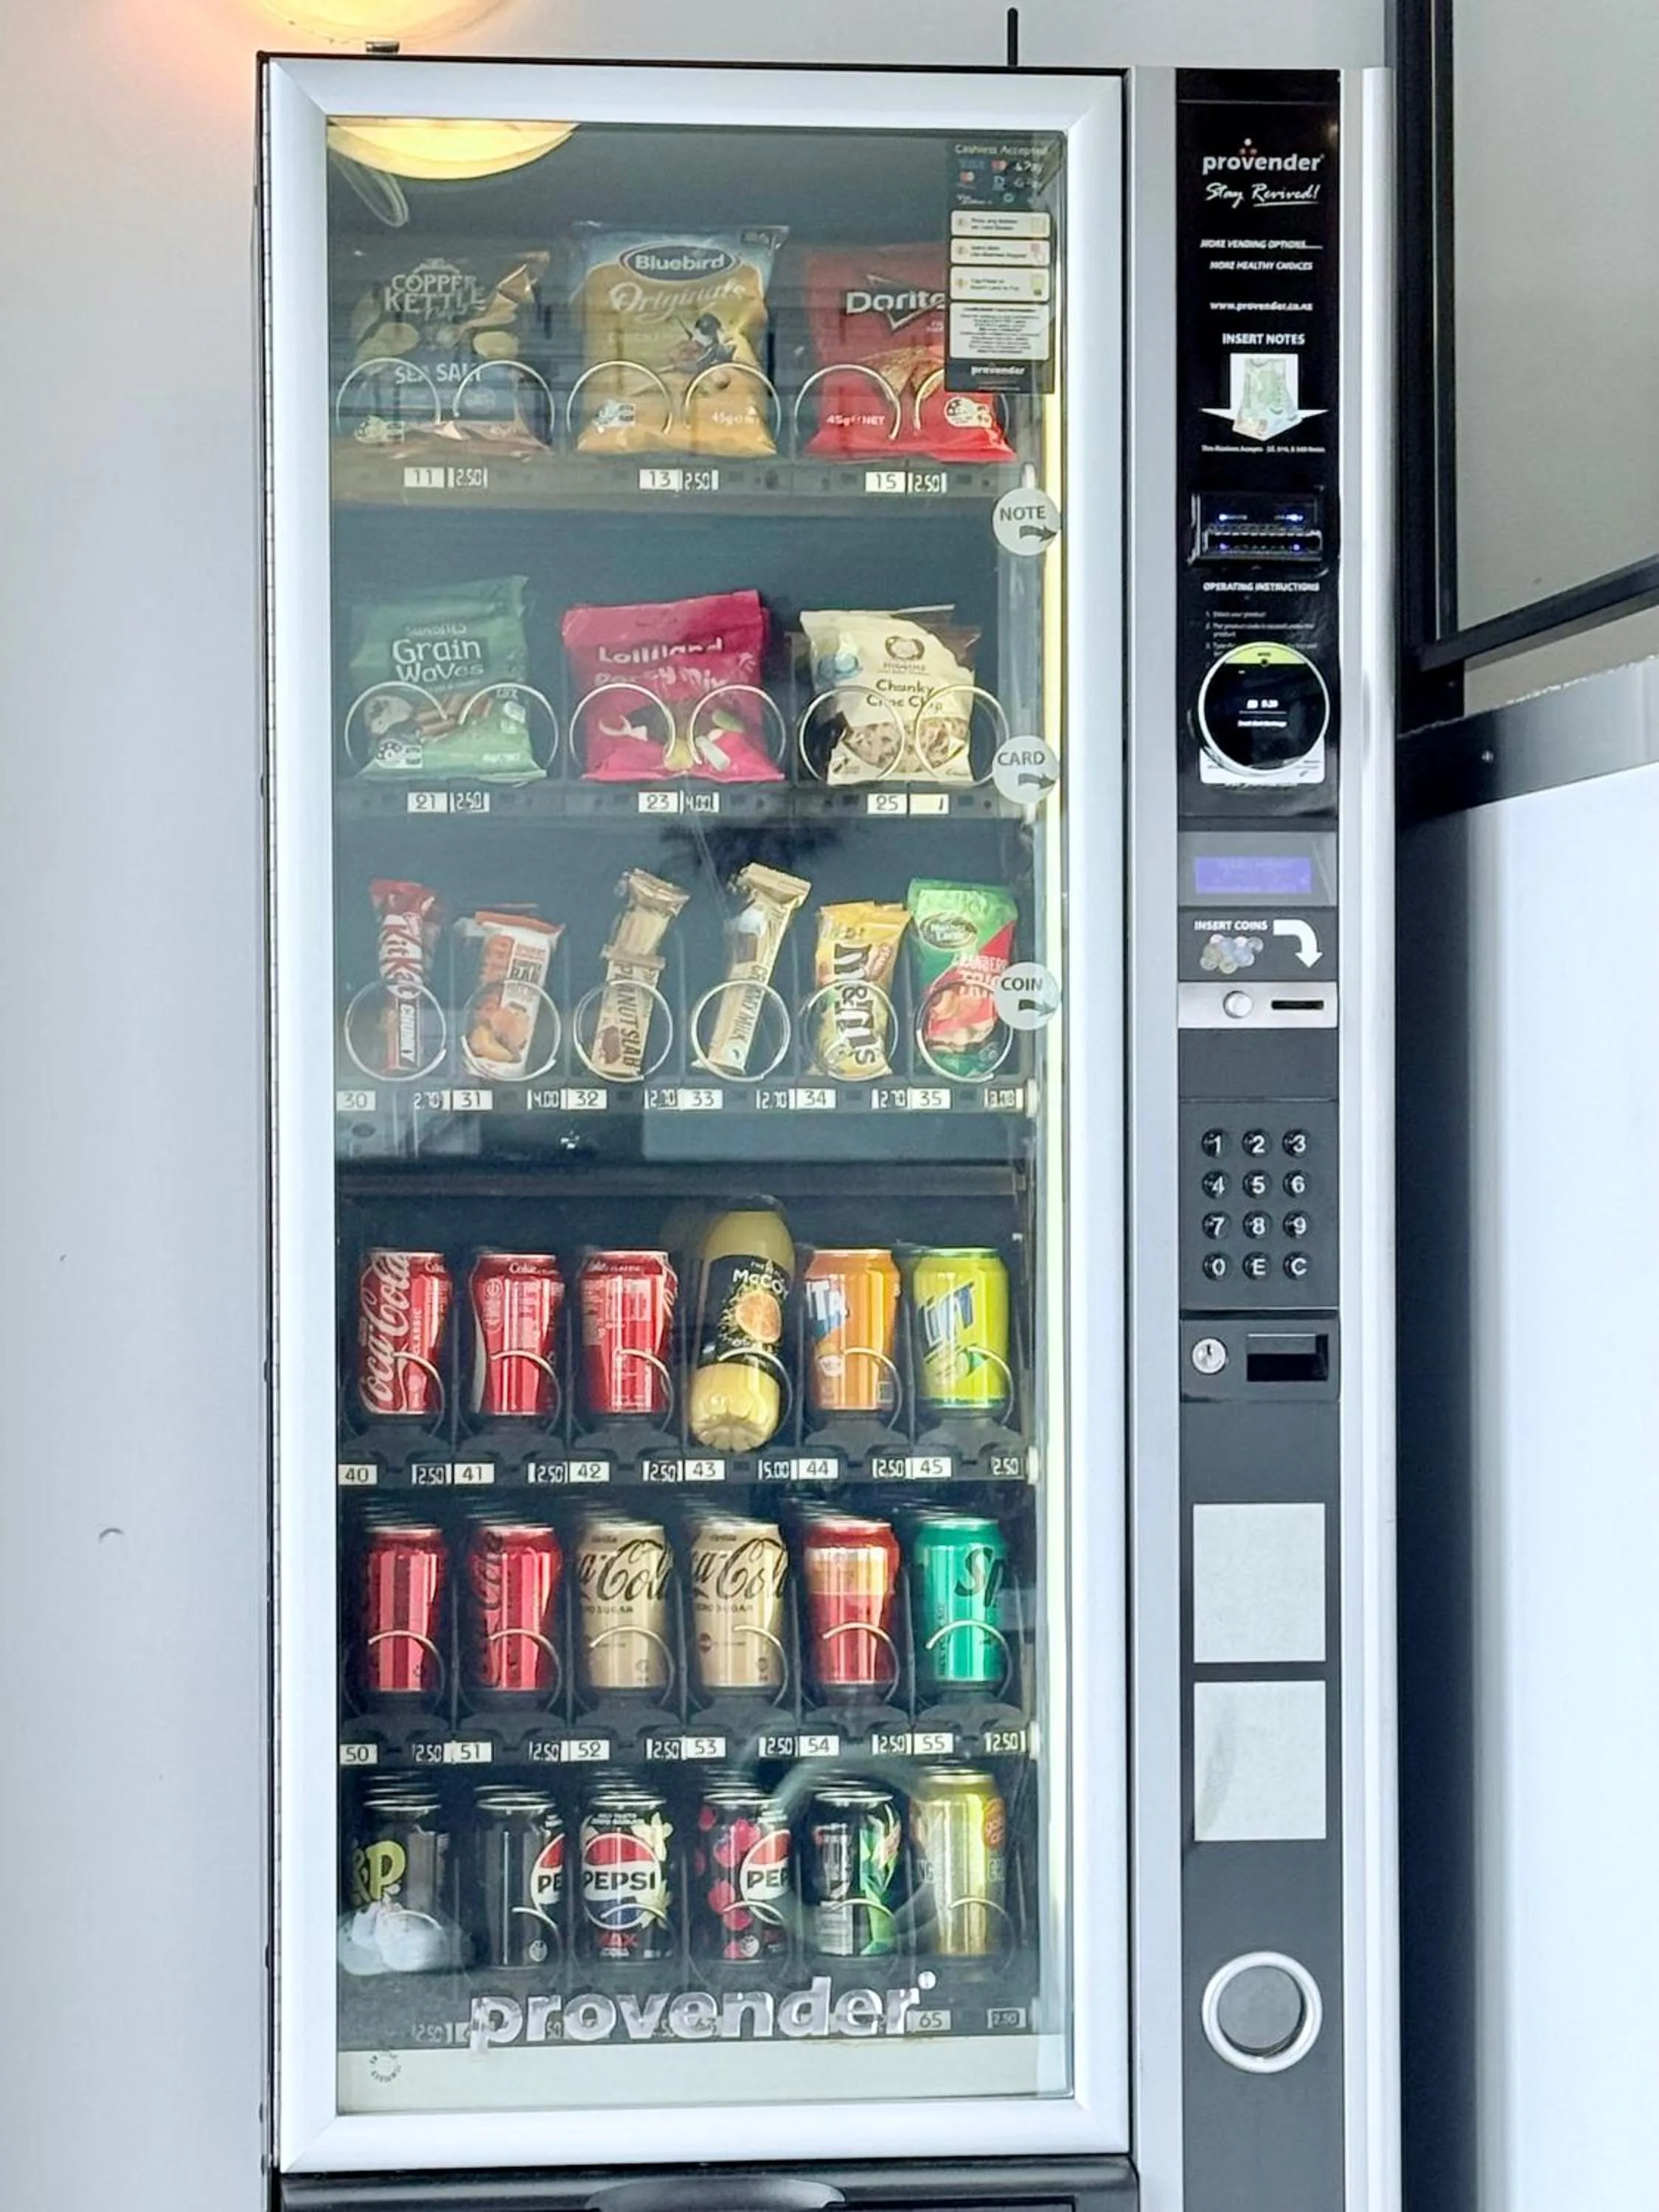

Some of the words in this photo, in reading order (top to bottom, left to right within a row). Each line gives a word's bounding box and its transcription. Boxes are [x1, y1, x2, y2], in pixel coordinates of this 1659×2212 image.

[1202, 153, 1324, 175] provender
[1206, 182, 1245, 209] Stay
[1251, 183, 1321, 204] Revived!
[634, 254, 725, 271] Bluebird
[392, 274, 477, 293] COPPER
[384, 286, 487, 314] KETTLE
[846, 291, 945, 314] Dorito
[1210, 301, 1313, 312] www.provender.co.nz
[1222, 333, 1263, 345] INSERT
[1265, 333, 1306, 345] NOTES
[414, 470, 431, 485] 11
[456, 469, 482, 487] 2.50
[650, 470, 671, 487] 13
[684, 472, 710, 490] 2.50
[876, 473, 896, 489] 15
[914, 474, 941, 492] 2.50
[1000, 505, 1047, 521] NOTE
[1203, 581, 1253, 592] OPERATING
[1255, 581, 1321, 592] INSTRUCTIONS
[392, 639, 481, 664] Grain
[598, 636, 723, 664] Lolliland
[396, 662, 484, 683] Waves
[876, 678, 934, 699] Chunky
[998, 751, 1046, 766] CARD
[414, 793, 437, 810] 21
[456, 792, 483, 812] 2.50
[646, 793, 670, 811] 23
[875, 795, 899, 812] 25
[1194, 919, 1233, 931] INSERT
[1234, 919, 1268, 931] COINS
[1000, 976, 1043, 992] COIN
[344, 1093, 367, 1108] 30
[460, 1092, 481, 1107] 31
[577, 1092, 599, 1106] 32
[692, 1091, 714, 1106] 33
[803, 1091, 827, 1105] 34
[919, 1091, 942, 1105] 35
[1213, 1135, 1222, 1154] 1
[1252, 1135, 1265, 1153] 2
[1293, 1135, 1306, 1152] 3
[1211, 1176, 1225, 1194] 4
[1252, 1176, 1266, 1194] 5
[1291, 1175, 1305, 1194] 6
[1212, 1217, 1225, 1236] 7
[1252, 1217, 1266, 1235] 8
[1293, 1216, 1307, 1235] 9
[1211, 1258, 1225, 1276] 0
[1252, 1258, 1266, 1276] E
[1291, 1257, 1308, 1276] C
[344, 1468, 369, 1482] 40
[419, 1467, 445, 1483] 2.50
[462, 1467, 482, 1481] 41
[537, 1466, 564, 1482] 2.50
[577, 1464, 602, 1479] 42
[650, 1464, 676, 1481] 2.50
[692, 1462, 716, 1478] 43
[806, 1461, 830, 1475] 44
[877, 1459, 904, 1477] 2.50
[919, 1460, 944, 1475] 45
[992, 1458, 1018, 1475] 2.50
[577, 1742, 602, 1758] 52
[653, 1741, 679, 1759] 2.50
[694, 1740, 717, 1756] 53
[766, 1739, 793, 1756] 2.50
[807, 1739, 830, 1753] 54
[881, 1736, 905, 1753] 2.50
[922, 1736, 945, 1750] 55
[993, 1733, 1019, 1750] 2.50
[346, 1747, 369, 1762] 50
[414, 1745, 442, 1762] 2.50
[460, 1745, 479, 1761] 51
[533, 1744, 560, 1761] 2.50
[584, 1871, 655, 1891] PEPSI
[470, 1976, 920, 2054] provender
[919, 2014, 943, 2028] 65
